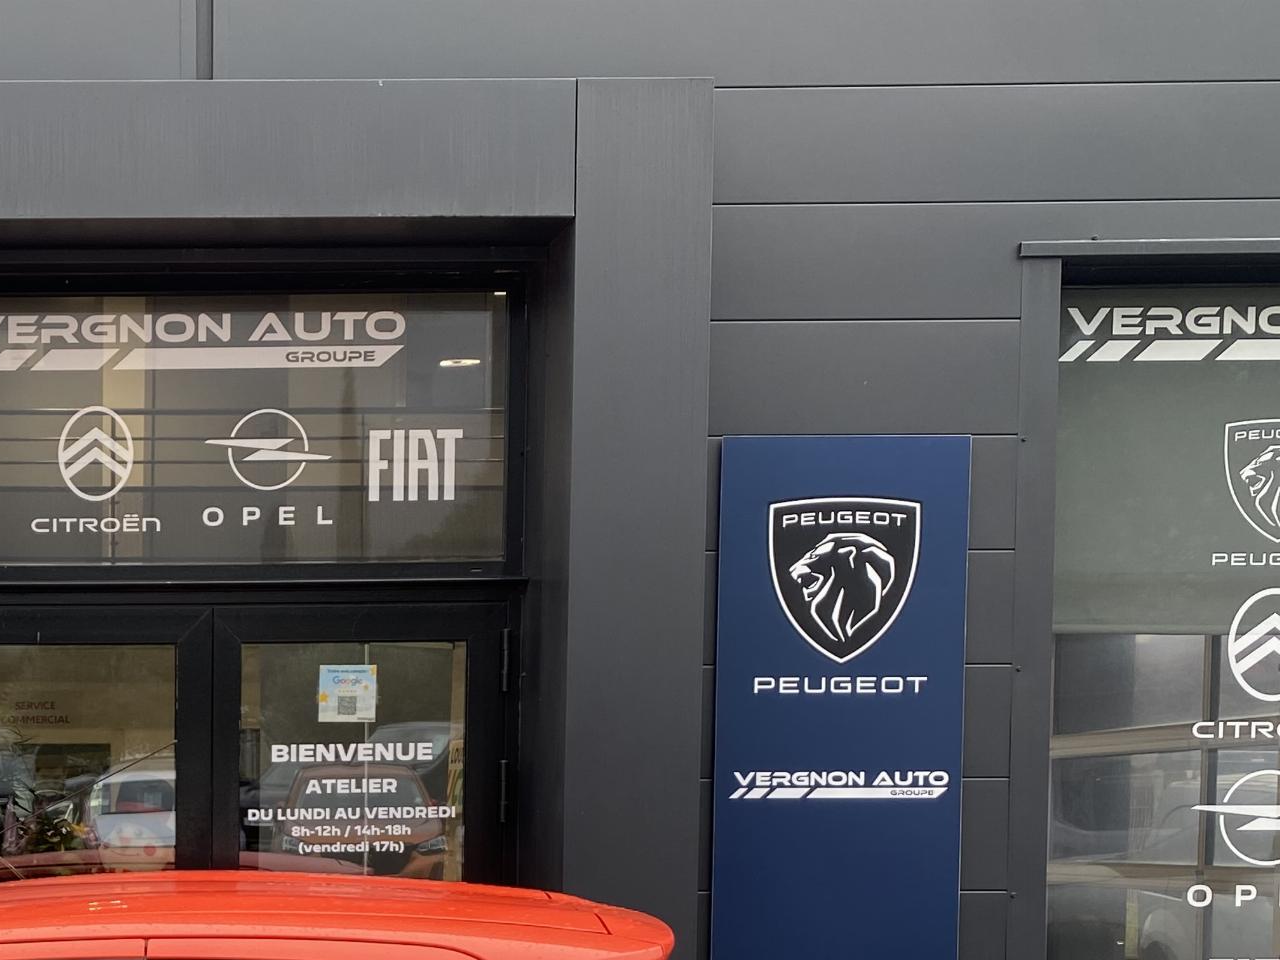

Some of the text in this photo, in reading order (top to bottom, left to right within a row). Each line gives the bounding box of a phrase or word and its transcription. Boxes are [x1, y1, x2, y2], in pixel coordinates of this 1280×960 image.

[248, 312, 405, 341] AUTO
[286, 351, 375, 362] GROUPE
[369, 429, 463, 501] FIAT
[203, 506, 332, 526] OPEL
[783, 511, 906, 527] PEUGEOT
[754, 677, 927, 693] PEUGEOT
[15, 701, 57, 711] SERVICE
[1193, 722, 1280, 738] CITR
[272, 743, 433, 762] BIENVENUE
[306, 778, 397, 794] ATELIER
[734, 771, 948, 786] VERGNON AUTO
[889, 788, 934, 797] GROUPE
[248, 805, 456, 821] DU LUNDI AU VENDREDI
[291, 825, 411, 838] 8h-12h / 14h-18h
[298, 841, 404, 854] (vendredi 17h)
[1187, 885, 1280, 907] OP
